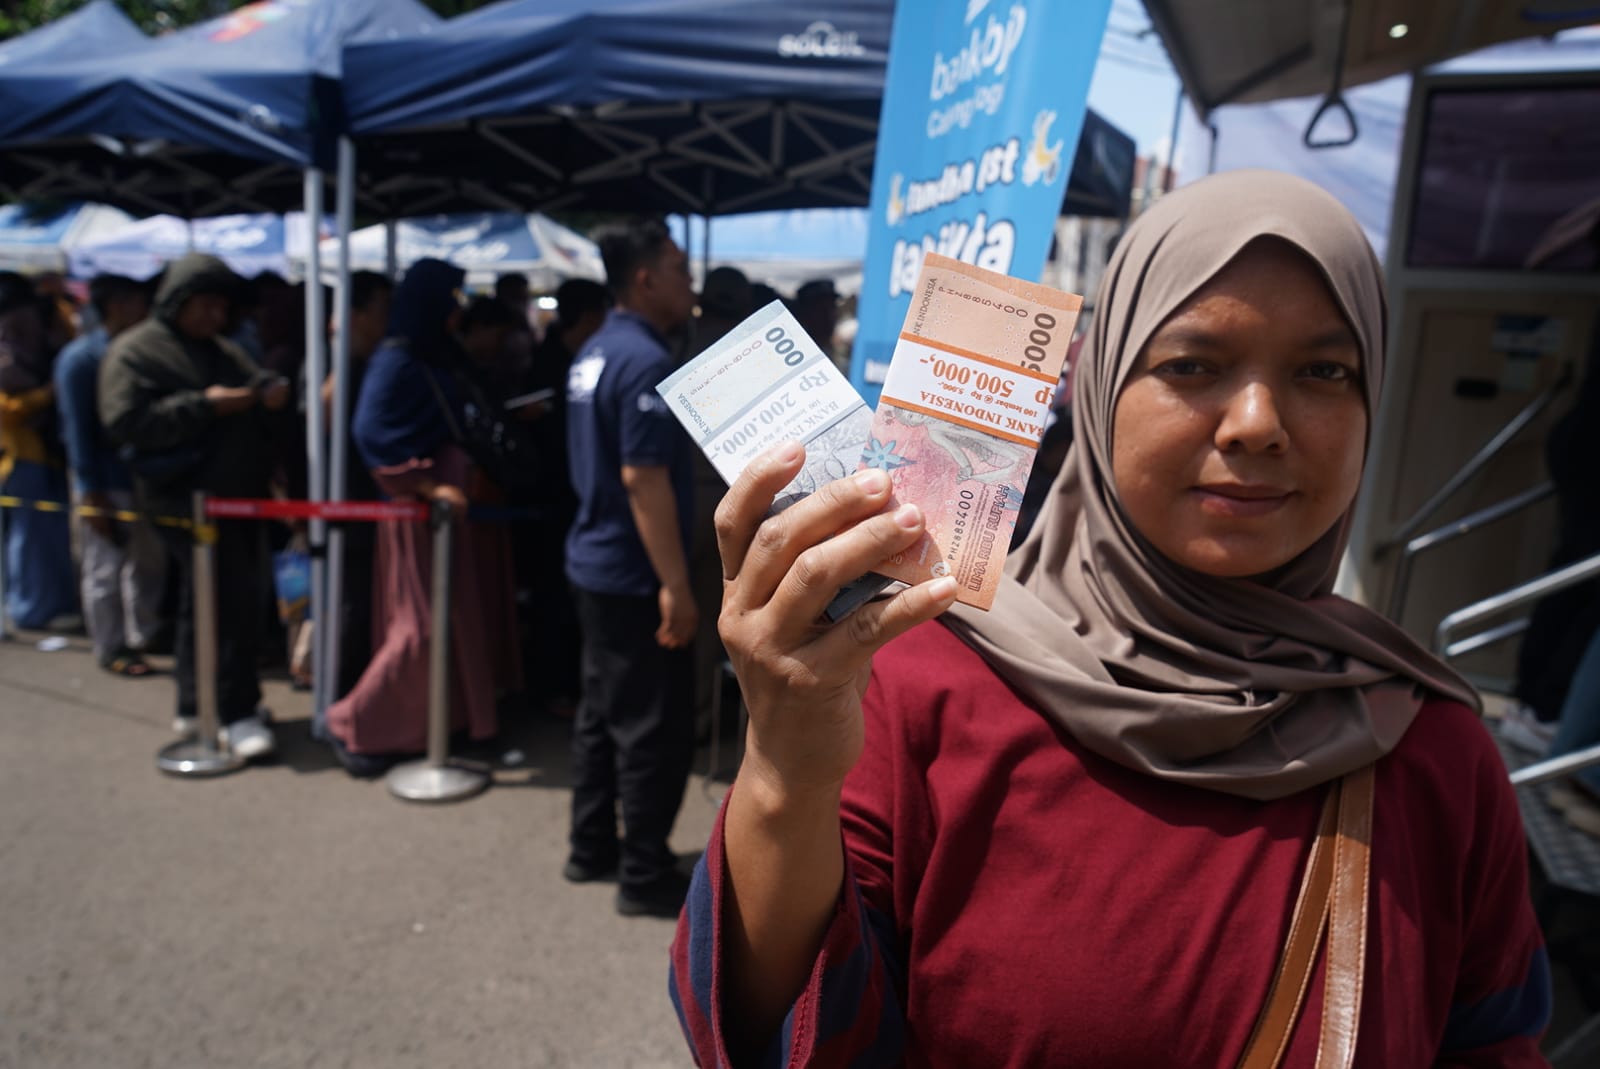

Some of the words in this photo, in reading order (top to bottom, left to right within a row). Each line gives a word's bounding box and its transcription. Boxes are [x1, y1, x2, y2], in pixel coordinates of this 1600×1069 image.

[917, 277, 936, 321] INDONESIA
[938, 287, 1028, 318] PHZ885400
[913, 321, 923, 335] NK
[799, 370, 830, 392] Rp
[969, 390, 982, 400] Rp
[919, 391, 1001, 424] INDONESIA
[995, 398, 1022, 412] lembar
[986, 484, 1010, 529] RUPIAH
[978, 530, 995, 559] RIBU
[967, 561, 987, 592] LIMA
